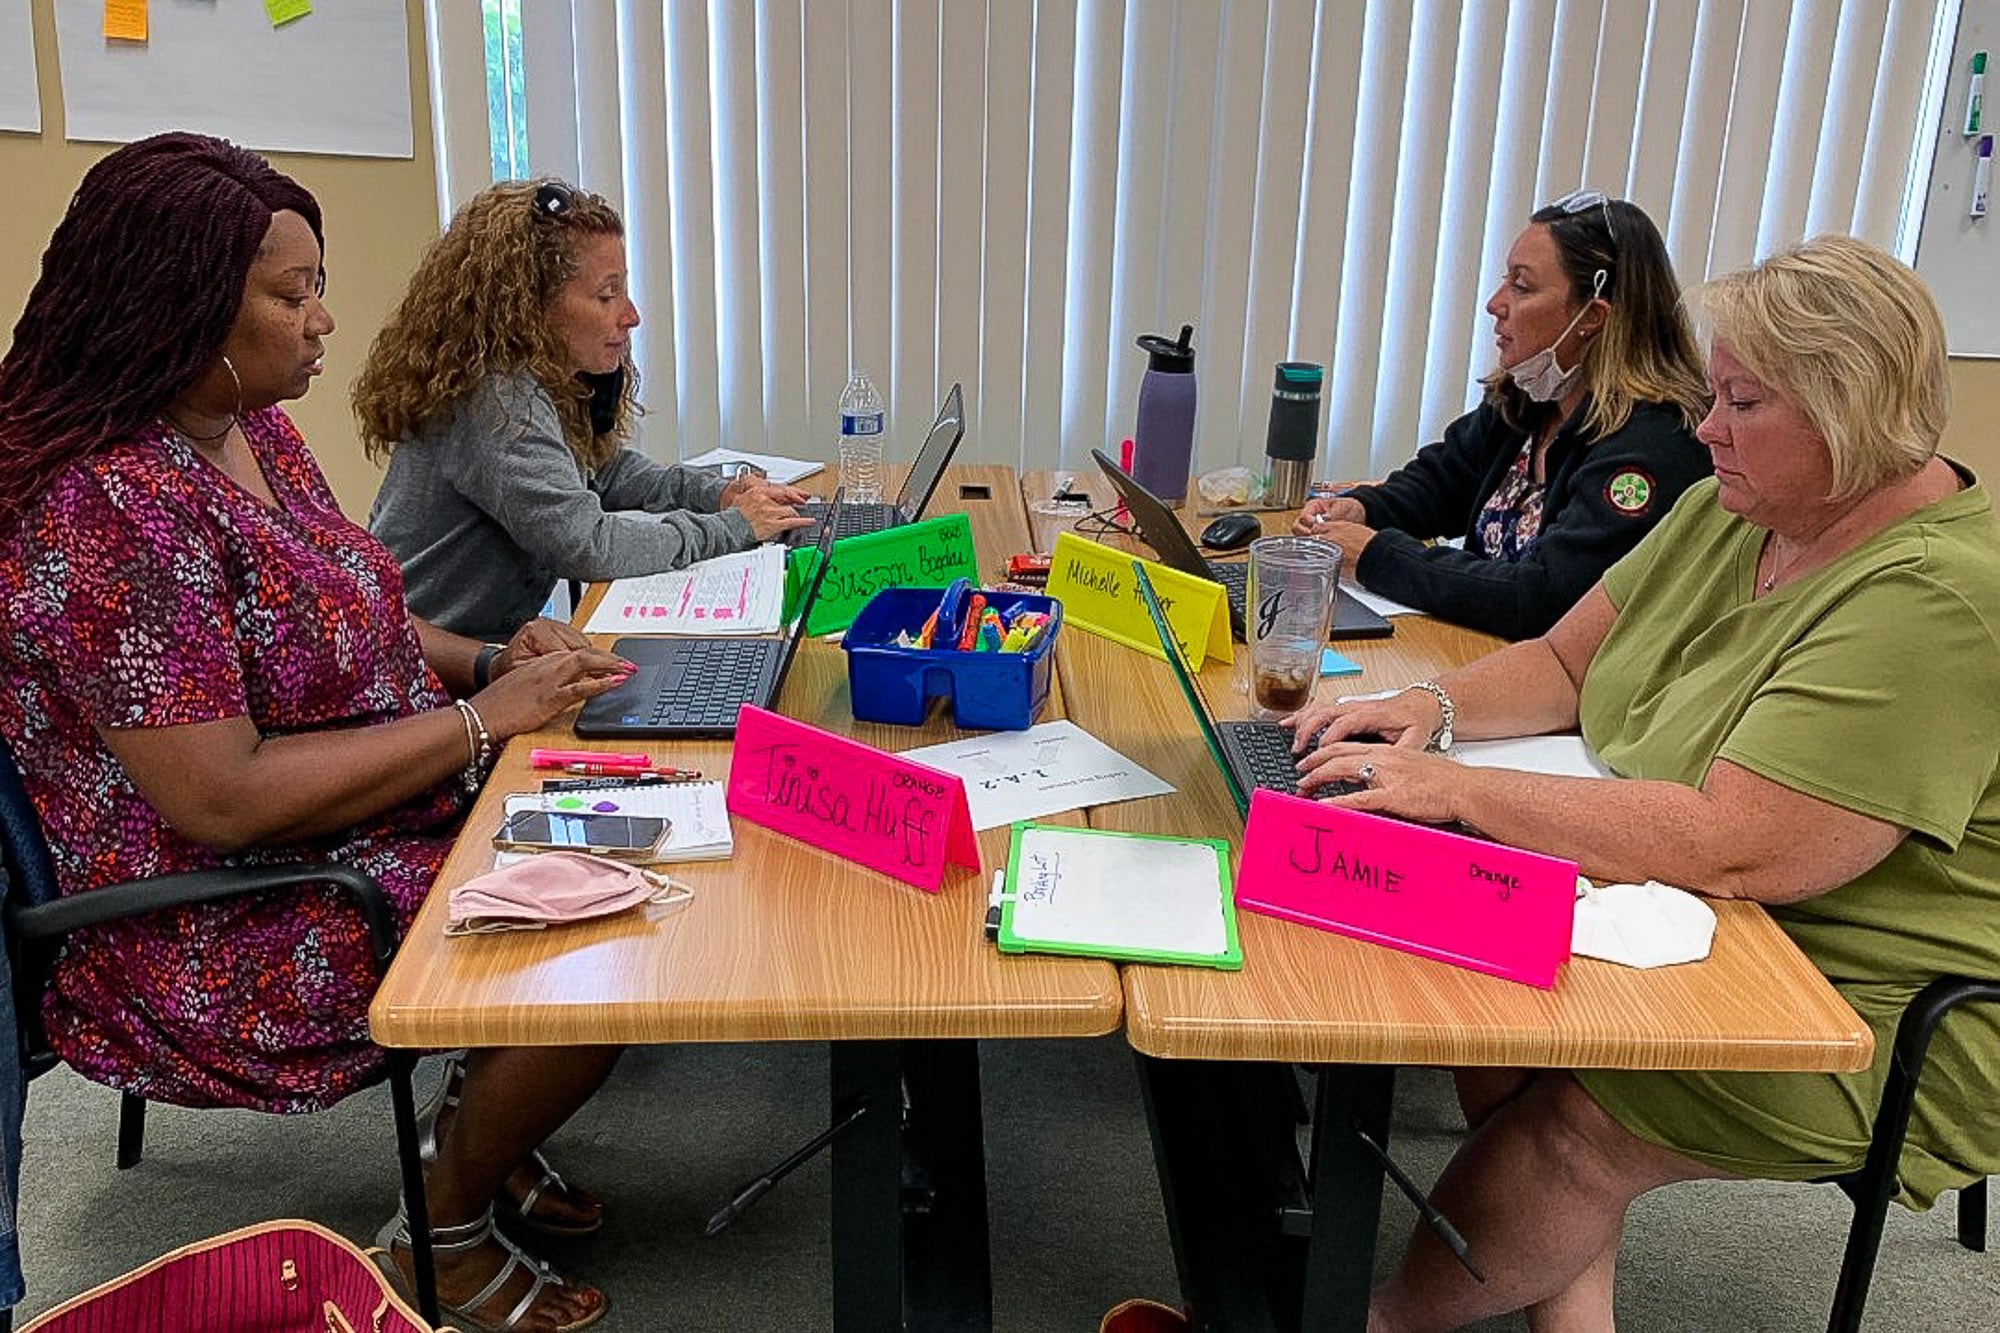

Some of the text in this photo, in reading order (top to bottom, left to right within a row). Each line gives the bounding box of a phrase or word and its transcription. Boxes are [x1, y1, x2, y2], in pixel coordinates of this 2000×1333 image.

[814, 561, 913, 601] Susan
[751, 744, 935, 867] Tinisa Huff
[892, 771, 946, 800] ORANGE
[1289, 824, 1405, 893] JAMIE
